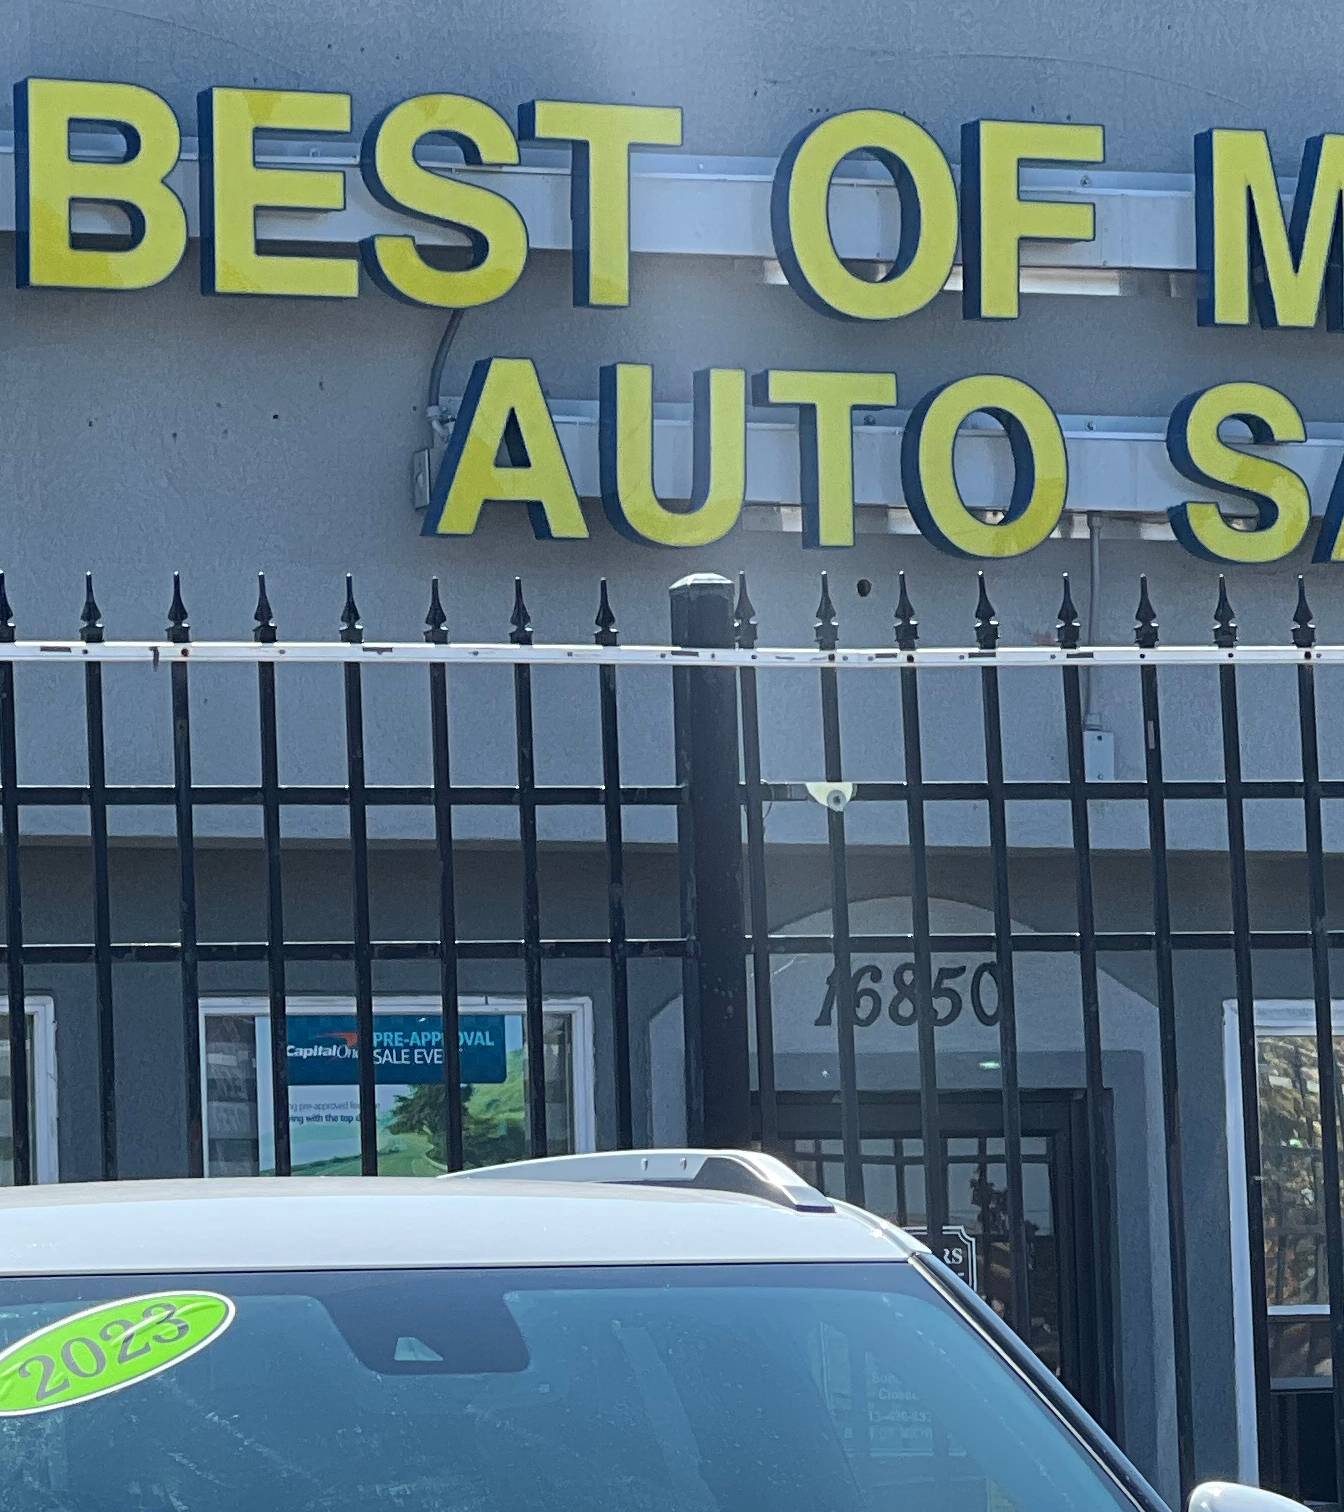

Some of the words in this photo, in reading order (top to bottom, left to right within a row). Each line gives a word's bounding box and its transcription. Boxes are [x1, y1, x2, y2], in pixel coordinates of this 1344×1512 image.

[16, 77, 683, 309] BEST
[772, 108, 1105, 320] OF
[422, 357, 1068, 559] AUTO
[814, 961, 1002, 1027] 16850
[373, 1031, 495, 1047] PRE-APPVAL
[373, 1049, 411, 1065] SALE
[19, 1303, 190, 1401] 2023
